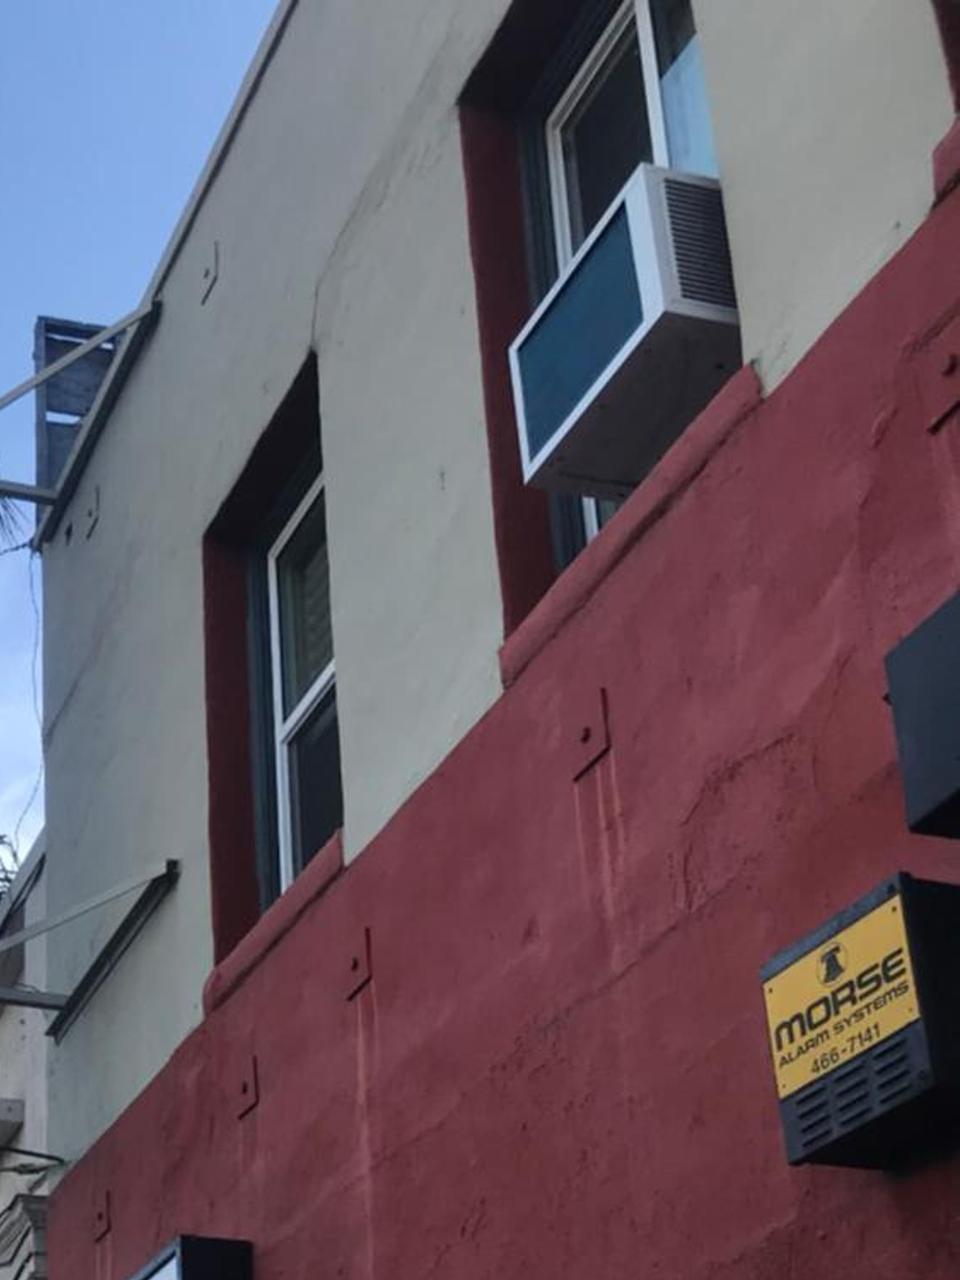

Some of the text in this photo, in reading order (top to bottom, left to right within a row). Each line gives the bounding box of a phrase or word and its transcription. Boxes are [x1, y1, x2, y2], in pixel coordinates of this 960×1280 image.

[774, 947, 907, 1051] MORSE
[778, 980, 910, 1069] ALARM SYSTEMS
[810, 1023, 881, 1075] 466-7141
